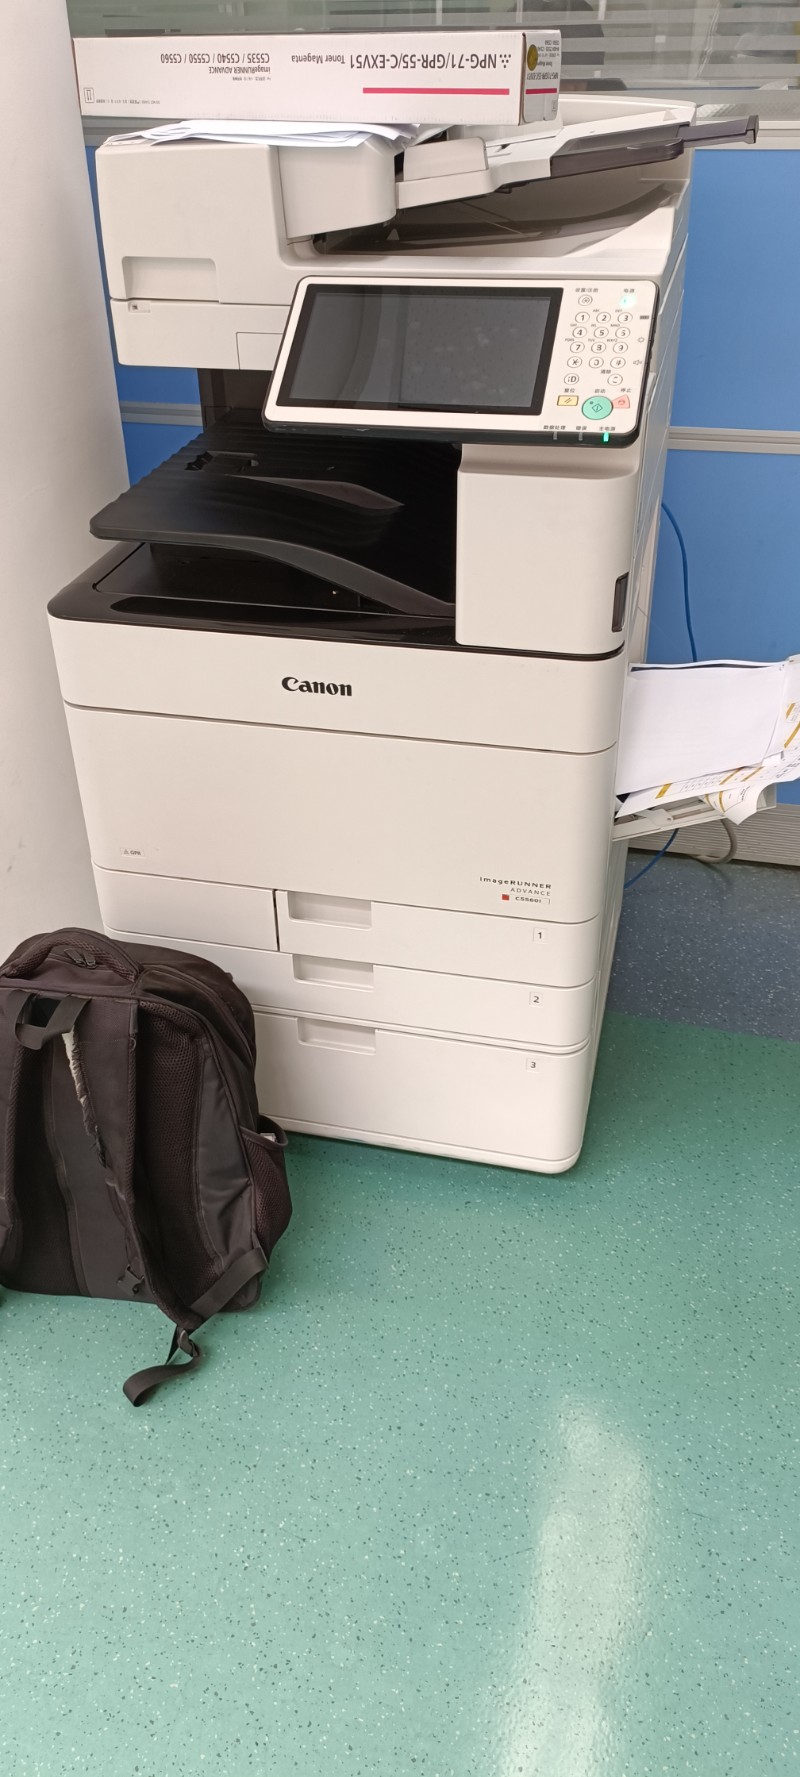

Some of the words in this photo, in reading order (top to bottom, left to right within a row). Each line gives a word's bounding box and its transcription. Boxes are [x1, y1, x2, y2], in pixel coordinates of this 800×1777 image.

[160, 53, 182, 63] C5560
[188, 53, 211, 63] C5550
[217, 53, 240, 63] C5540
[247, 53, 270, 63] C5535
[291, 53, 324, 64] Magenta
[325, 55, 346, 65] Toner
[349, 53, 497, 69] NPG-71/GPR-55/C-EXV51
[208, 66, 233, 74] ADVANCE
[234, 65, 271, 74] imageRUNNER
[281, 677, 352, 696] Canon
[479, 876, 552, 890] imageRUNNER
[510, 887, 551, 897] ADVANCE
[537, 931, 543, 940] 1
[532, 995, 540, 1004] 2
[530, 1061, 537, 1069] 3
